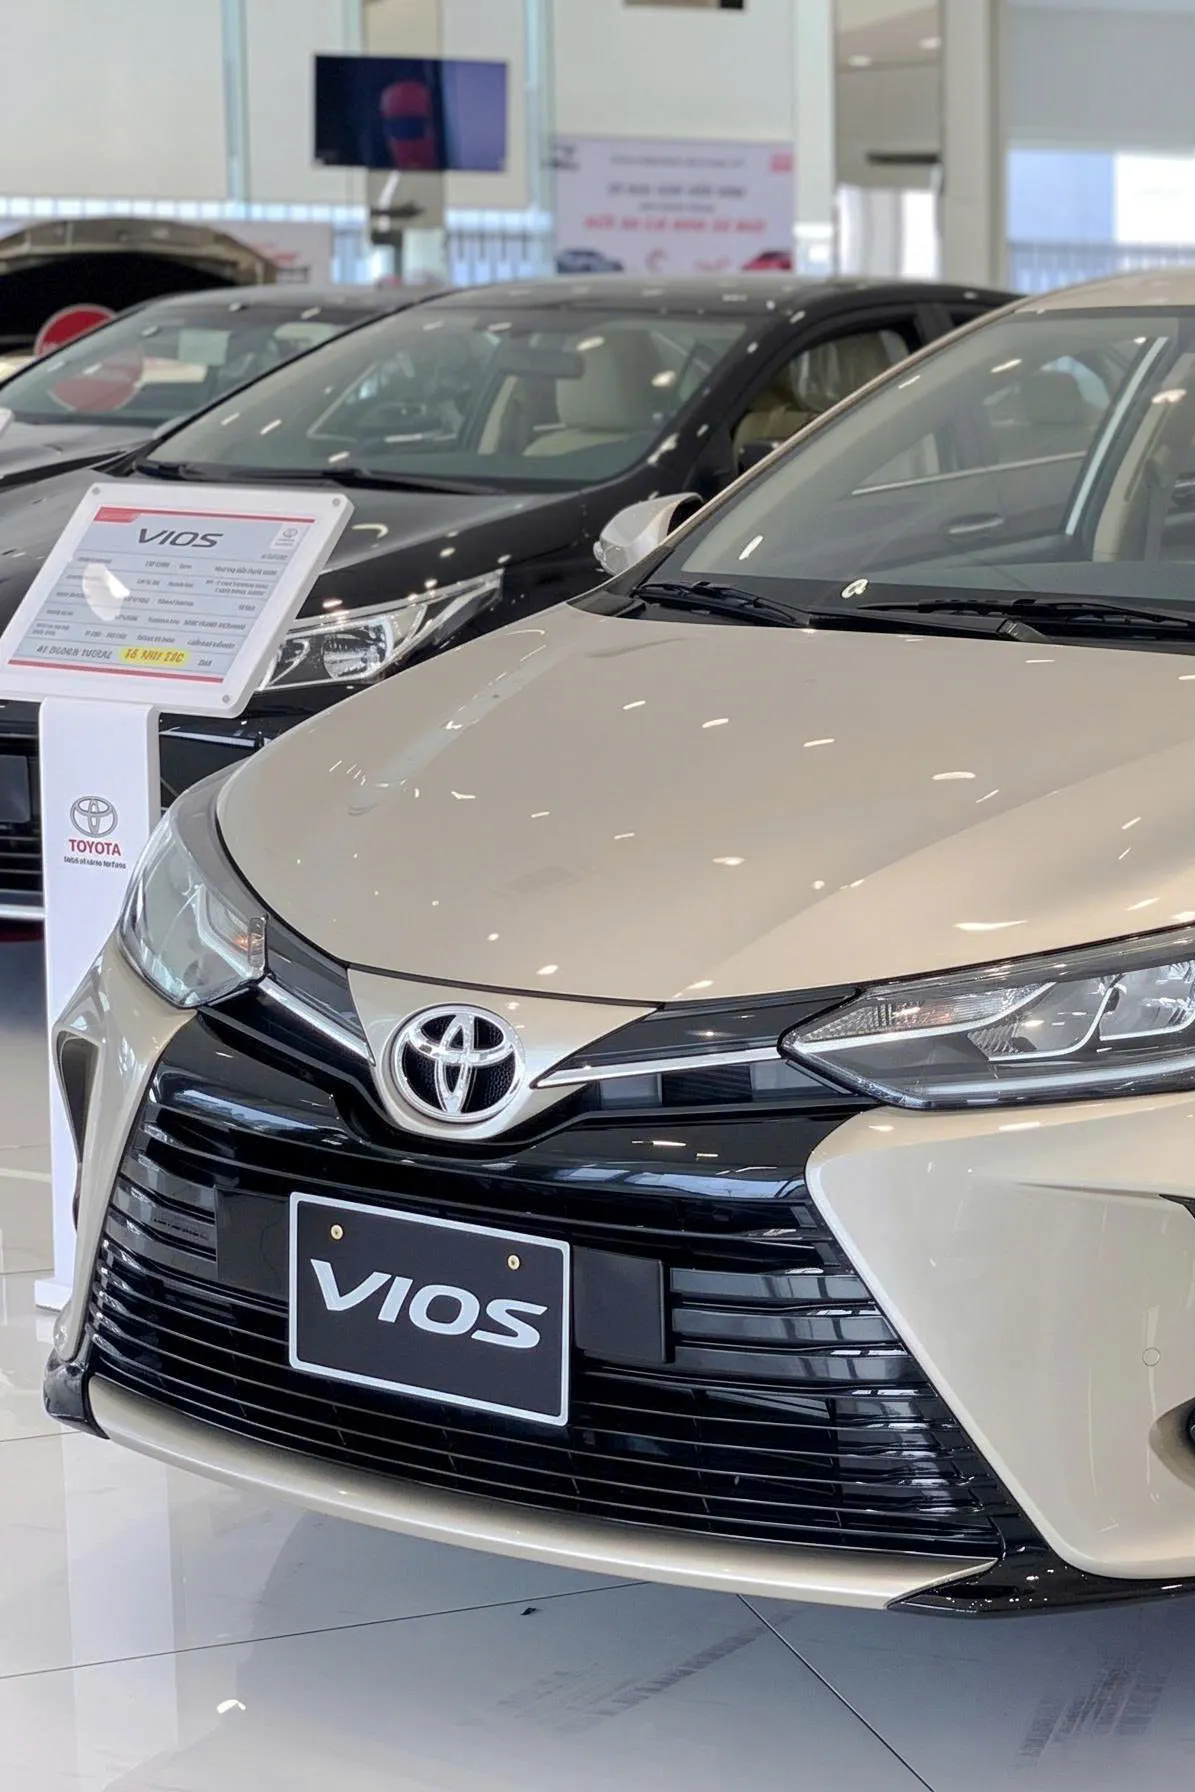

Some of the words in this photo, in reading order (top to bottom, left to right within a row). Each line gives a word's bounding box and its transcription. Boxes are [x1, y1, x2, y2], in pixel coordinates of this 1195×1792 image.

[138, 527, 224, 549] VIOS
[68, 838, 122, 857] TOYOTA
[310, 1258, 548, 1349] VIOS
